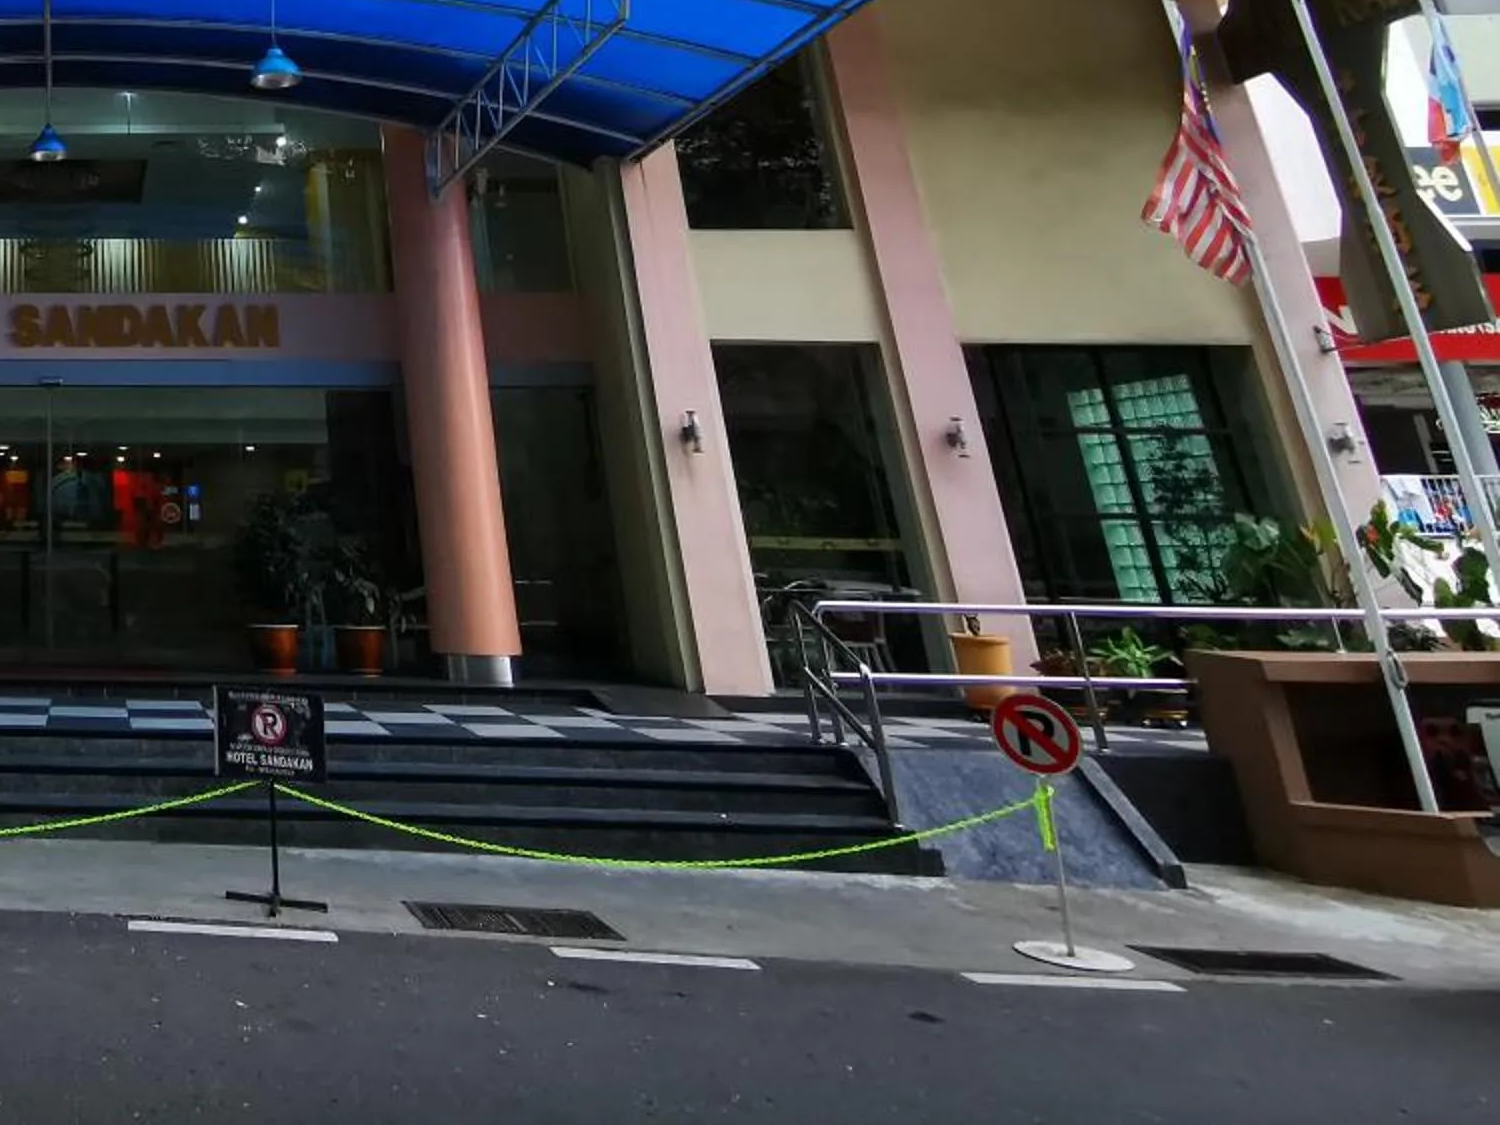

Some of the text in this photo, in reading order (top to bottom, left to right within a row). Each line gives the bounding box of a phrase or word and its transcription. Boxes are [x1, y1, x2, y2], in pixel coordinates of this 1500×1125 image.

[10, 303, 280, 348] SANDAKAN
[226, 751, 258, 765] HOTEL
[260, 754, 313, 771] SANDAKAN
